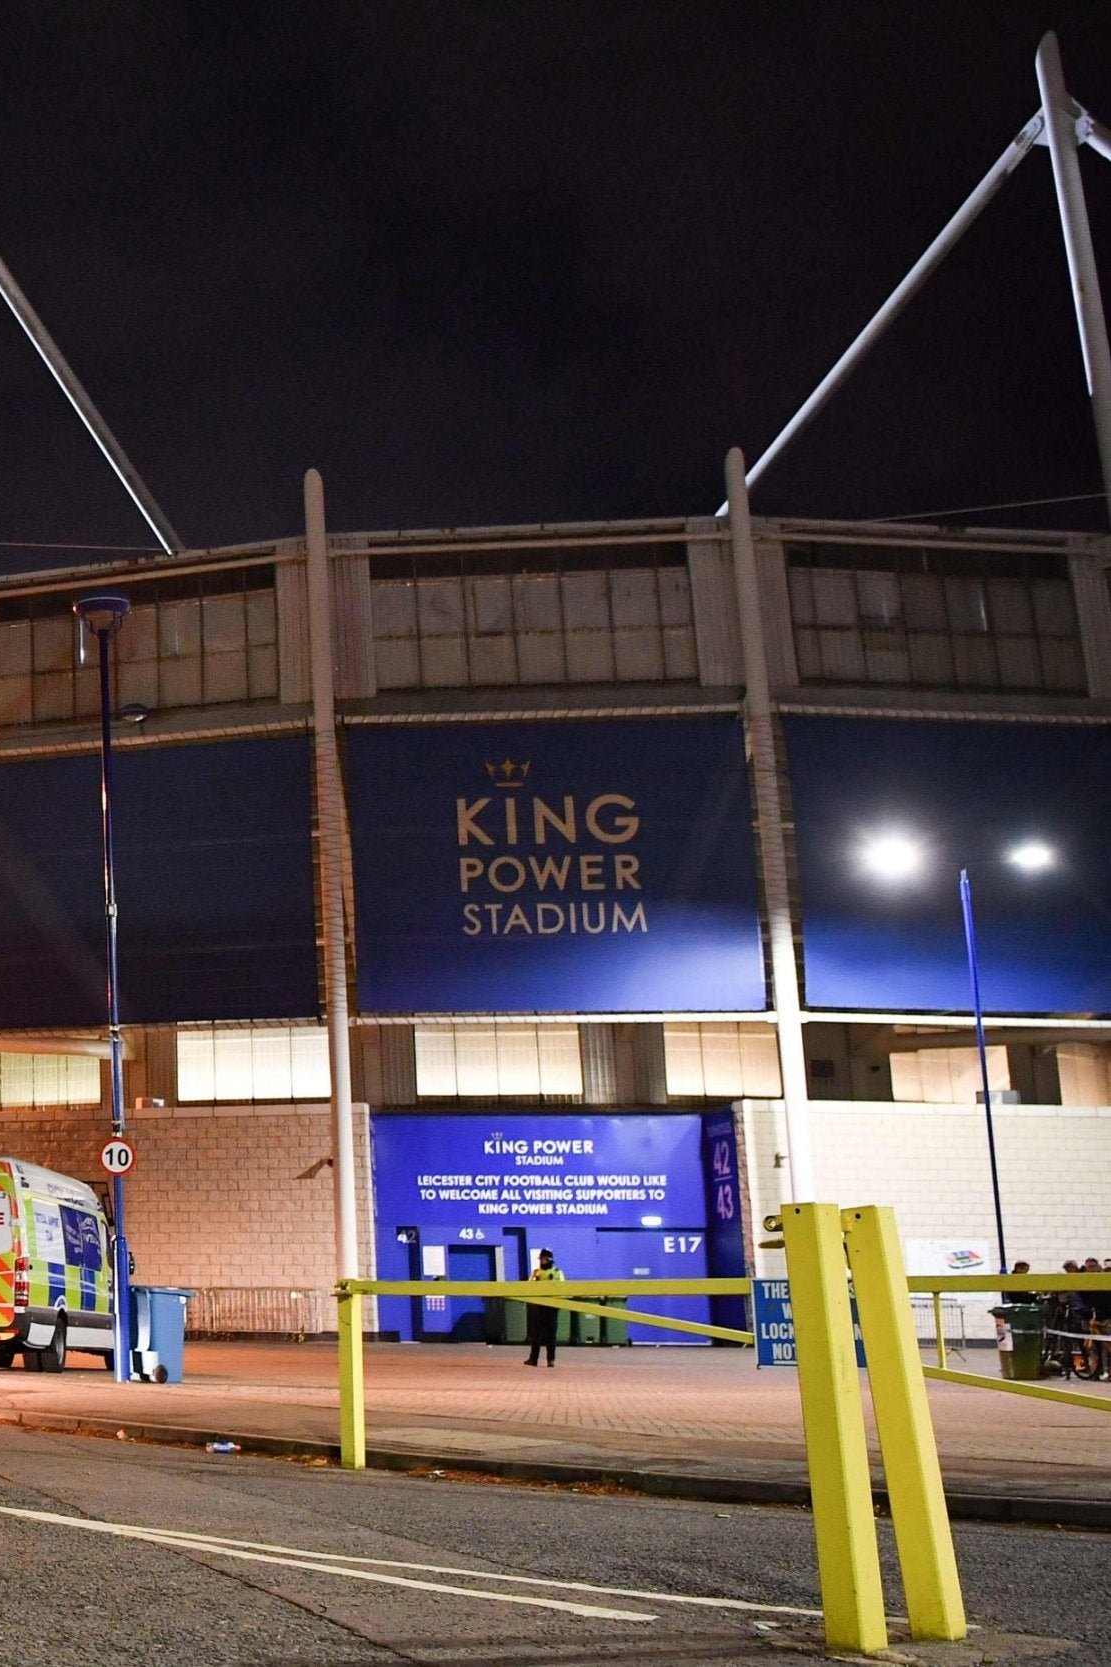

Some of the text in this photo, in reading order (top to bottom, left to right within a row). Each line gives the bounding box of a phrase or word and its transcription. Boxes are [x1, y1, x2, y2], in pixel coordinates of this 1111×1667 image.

[456, 793, 639, 846] KING
[459, 854, 642, 893] POWER
[462, 902, 648, 935] STADIUM
[484, 1140, 594, 1154] KING POWER
[105, 1148, 130, 1167] 10
[515, 1155, 564, 1166] STADIUM
[713, 1141, 731, 1175] 42
[417, 1175, 667, 1186] LEICESTER CITY FOOTBALL CLUB WOULD LIKE
[420, 1189, 665, 1200] TO WELCOME ALL VISITING SUPPORTERS TO
[717, 1185, 734, 1219] 43
[478, 1203, 608, 1215] KING POWER STADIUM
[397, 1230, 417, 1243] 42
[663, 1236, 702, 1253] E17
